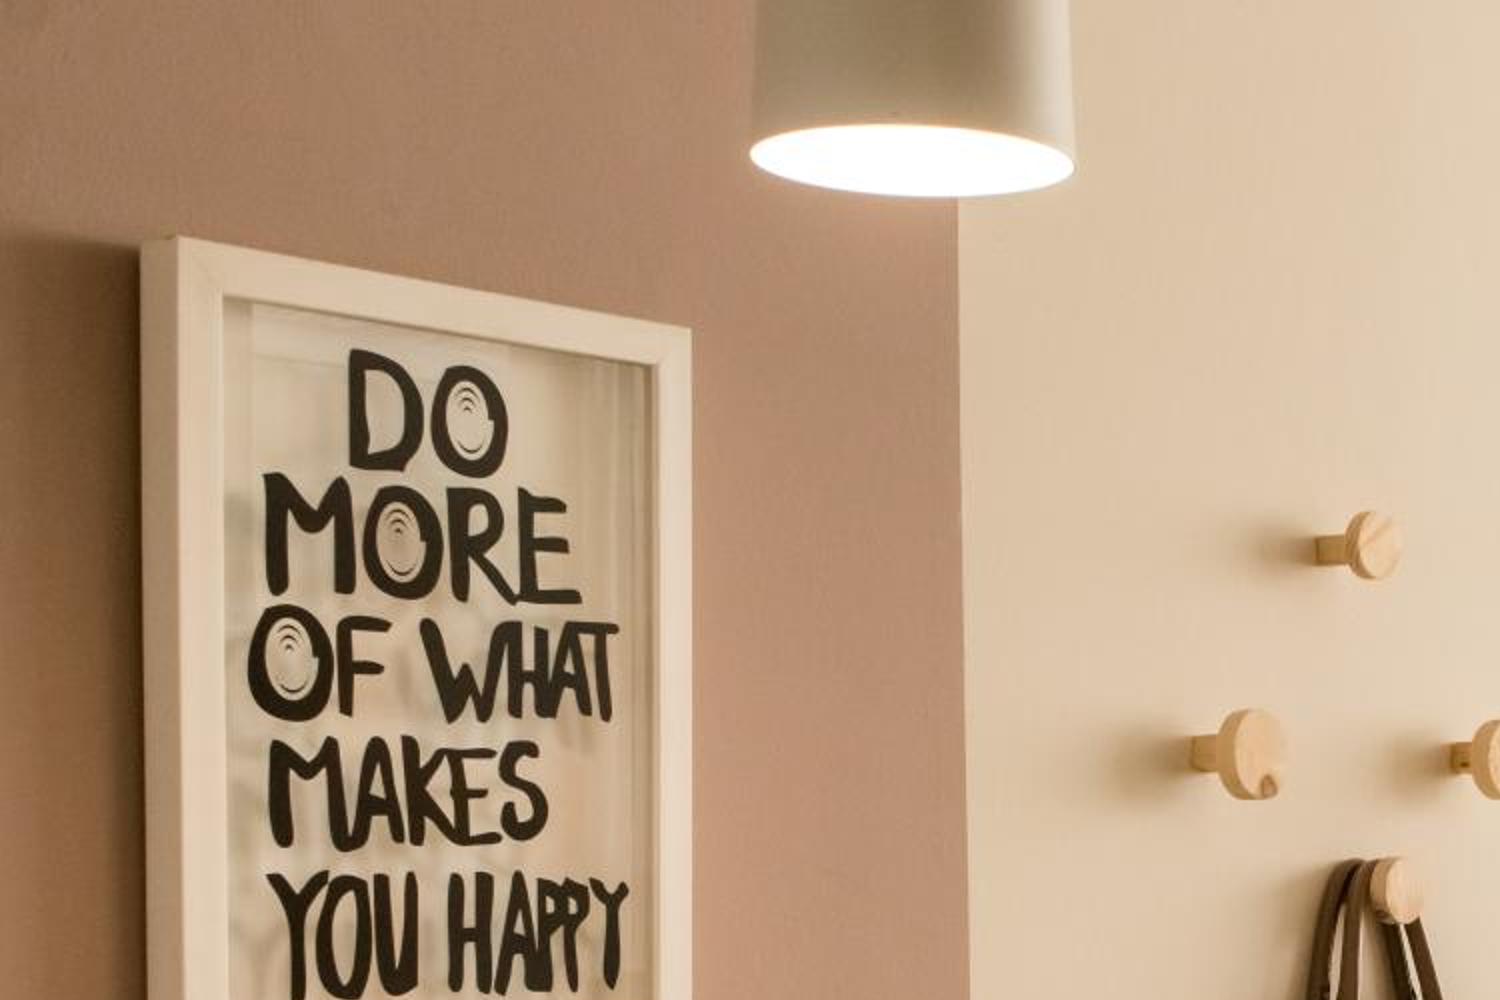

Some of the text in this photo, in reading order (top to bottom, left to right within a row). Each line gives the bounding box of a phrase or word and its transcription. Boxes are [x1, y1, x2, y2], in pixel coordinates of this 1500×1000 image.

[347, 348, 509, 479] DO
[263, 472, 583, 606] MORE
[247, 603, 620, 724] OF WHAT
[267, 735, 549, 852] MAKES
[447, 870, 630, 996] HAPPY
